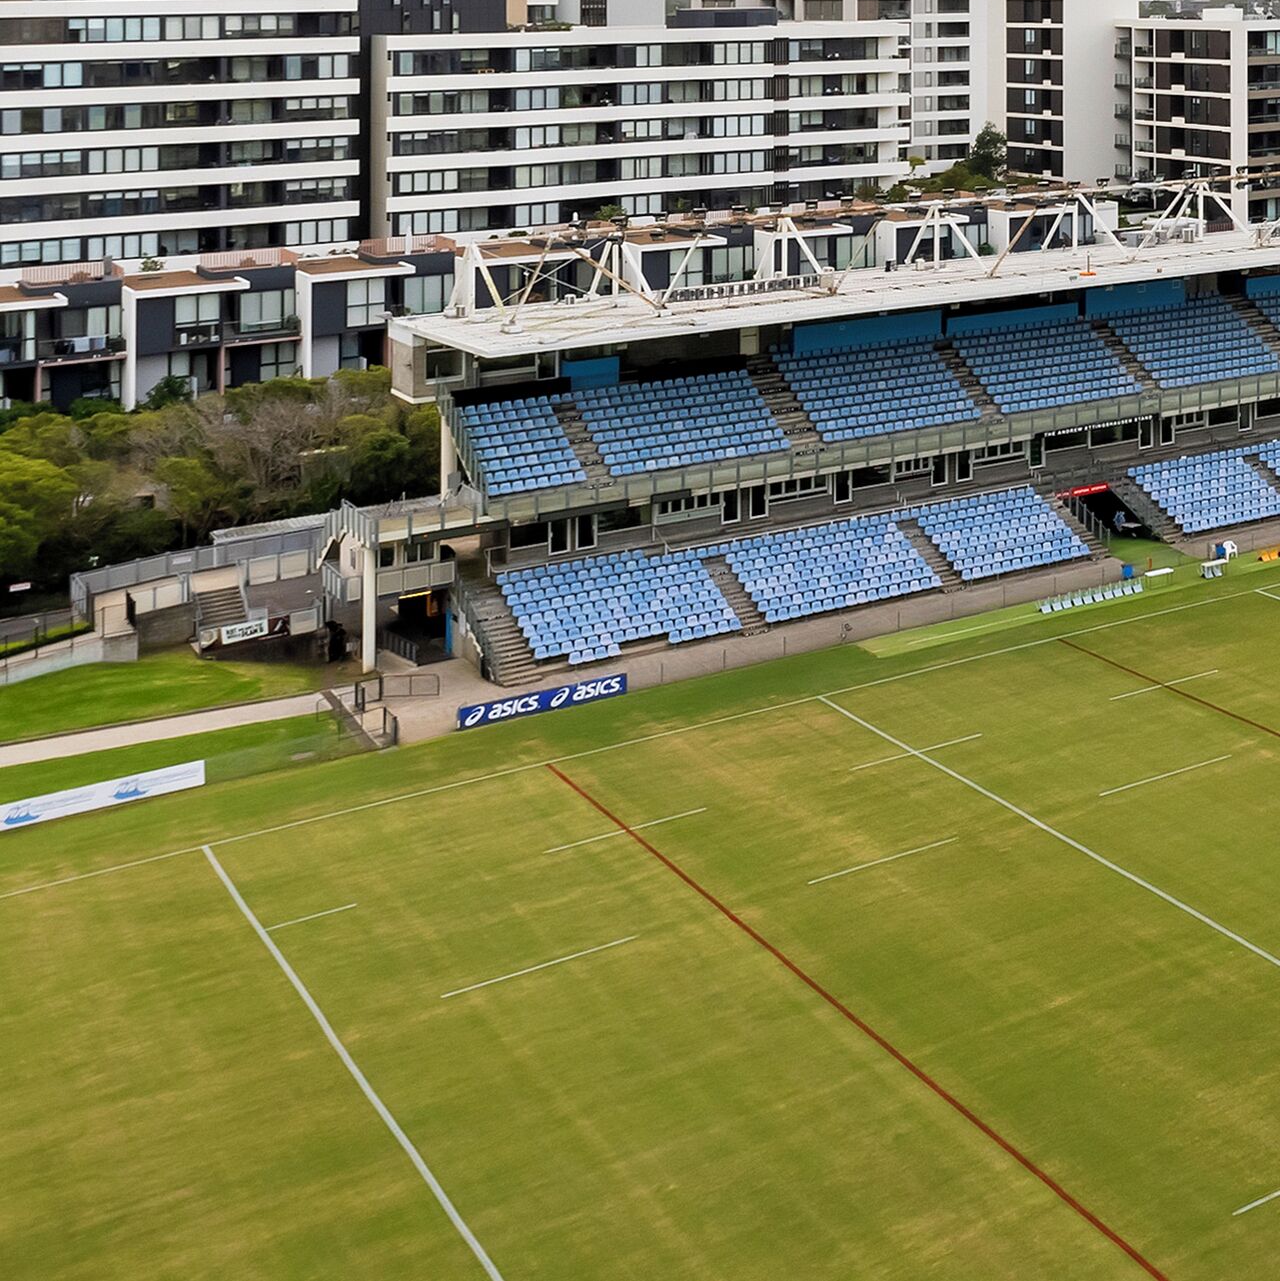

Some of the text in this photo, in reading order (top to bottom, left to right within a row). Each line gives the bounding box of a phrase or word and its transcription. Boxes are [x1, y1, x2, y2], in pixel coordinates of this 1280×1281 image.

[1057, 427, 1083, 435] ANDREW
[488, 677, 622, 719] asics asics
